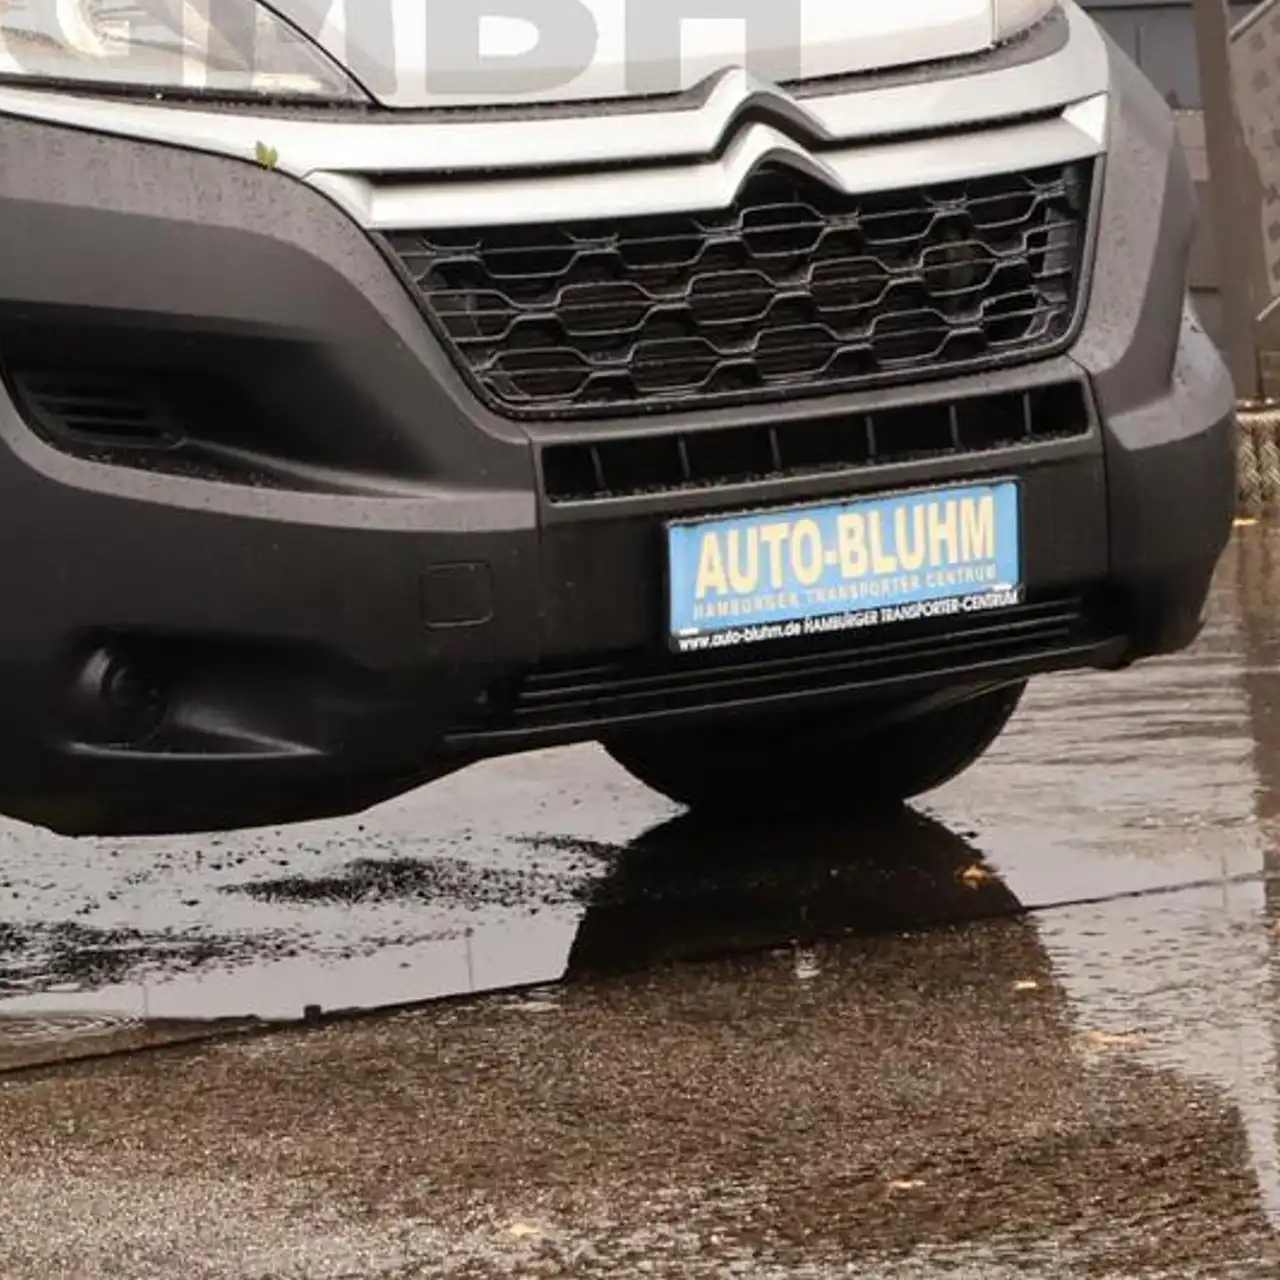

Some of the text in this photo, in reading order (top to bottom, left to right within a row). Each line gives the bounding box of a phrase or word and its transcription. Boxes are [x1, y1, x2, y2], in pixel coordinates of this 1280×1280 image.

[694, 495, 995, 599] AUTO-BLUHM
[679, 622, 802, 651] www.auto-bluhm.de
[804, 608, 878, 634] HAMBURGER
